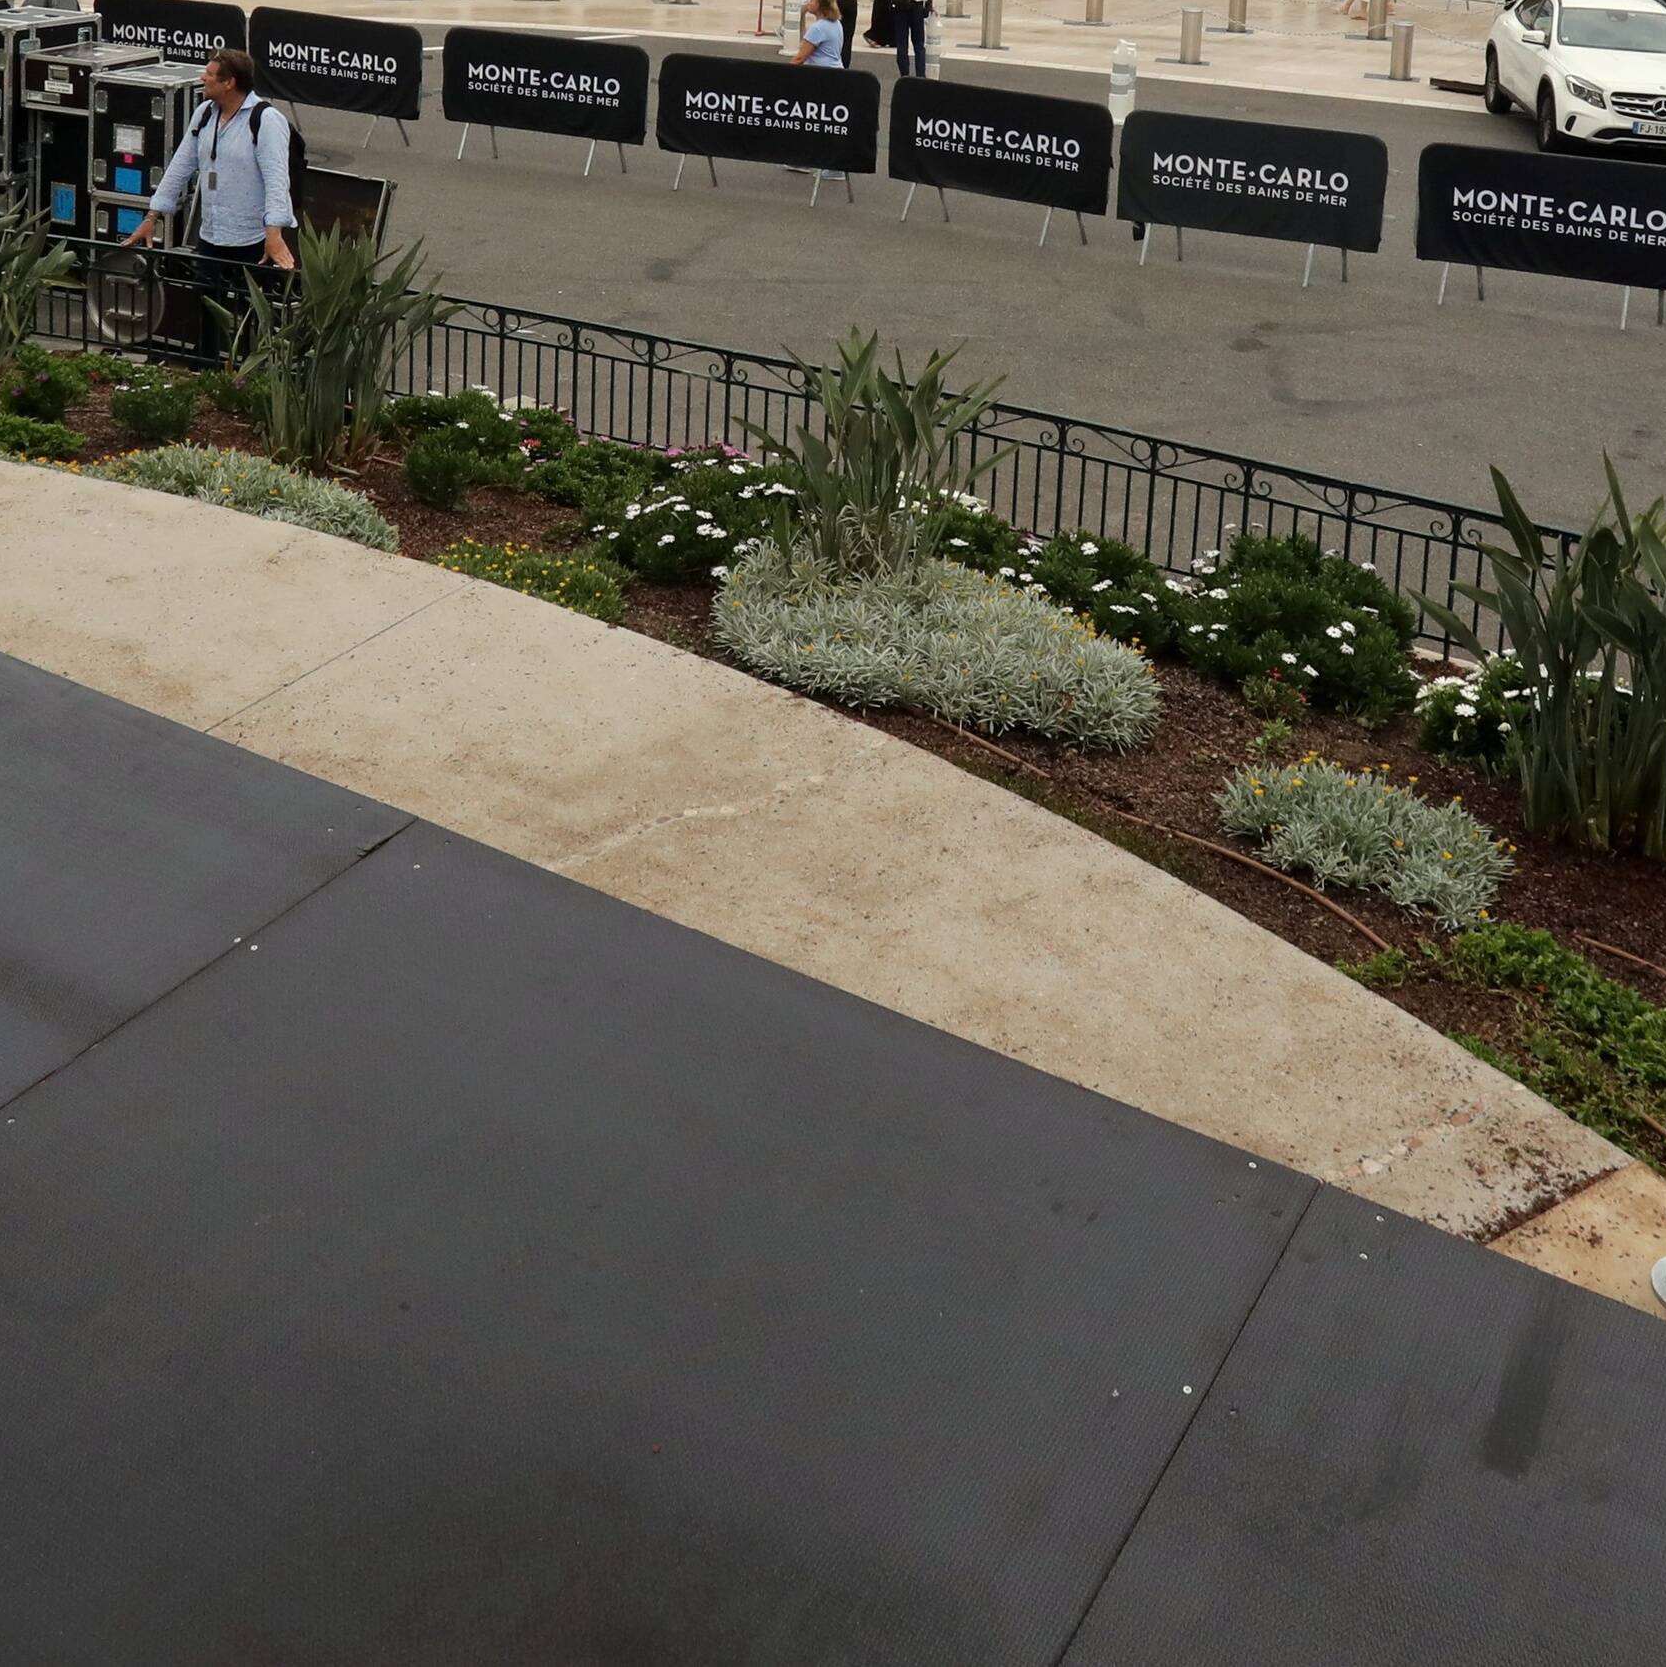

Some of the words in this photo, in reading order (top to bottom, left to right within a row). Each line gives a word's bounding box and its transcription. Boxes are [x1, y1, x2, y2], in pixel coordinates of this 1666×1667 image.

[166, 46, 192, 58] BAINS
[194, 50, 206, 60] DE
[268, 59, 307, 72] SOCIÉTÉ
[310, 65, 328, 75] DES
[330, 67, 359, 80] BAINS
[361, 72, 374, 82] DE
[377, 74, 397, 85] MER
[468, 81, 514, 95] SOCIÉTÉ
[517, 86, 538, 97] DES
[541, 89, 574, 102] BAINS
[578, 94, 593, 105] DE
[596, 96, 620, 108] MER
[685, 110, 734, 124] SOCIÉTÉ
[738, 115, 761, 126] DES
[765, 118, 801, 130] BAINS
[804, 122, 820, 133] DE
[824, 124, 848, 136] MER
[915, 137, 964, 154] SOCIÉTÉ
[968, 145, 991, 158] DES
[995, 149, 1031, 164] BAINS
[1035, 156, 1051, 167] DE
[1055, 159, 1079, 172] MER
[1152, 174, 1211, 191] SOCIÉTÉ
[1216, 181, 1242, 194] DES
[1247, 185, 1290, 200] BAINS
[1295, 190, 1314, 203] DE
[1319, 193, 1347, 207] MER
[1452, 210, 1515, 228] SOCIÉTÉ
[1521, 218, 1550, 232] DES
[1555, 223, 1602, 239] BAINS
[1608, 229, 1628, 242] DE
[1634, 232, 1666, 247] MER
